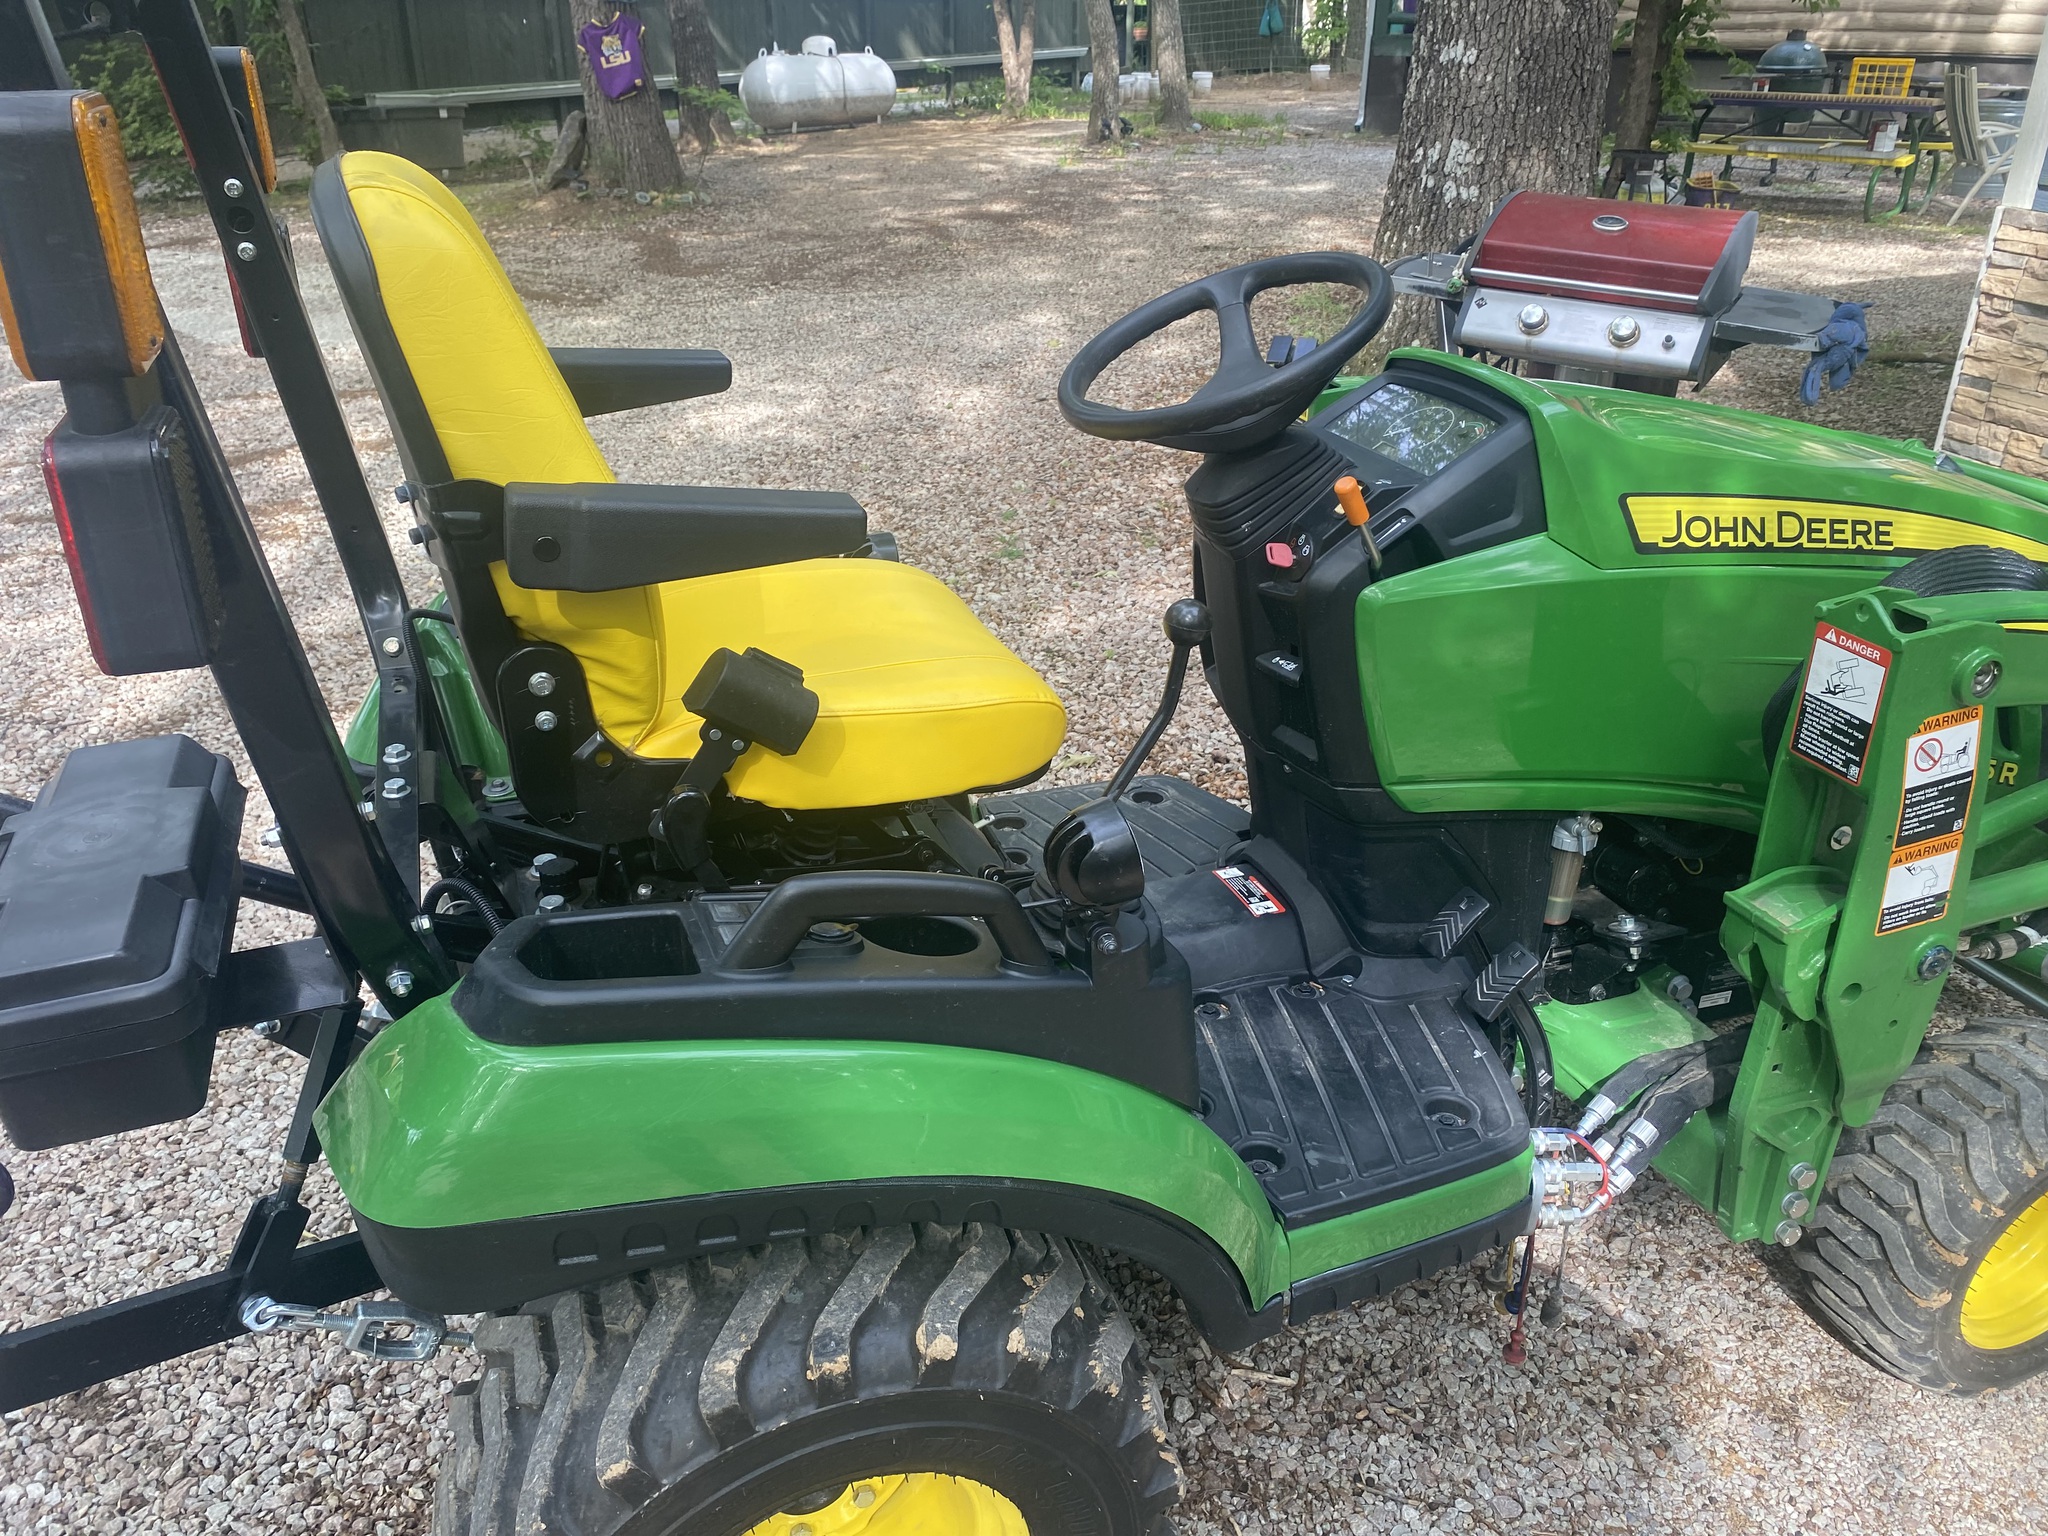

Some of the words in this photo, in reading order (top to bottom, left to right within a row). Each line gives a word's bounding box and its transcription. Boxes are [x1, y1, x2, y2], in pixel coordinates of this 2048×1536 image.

[600, 50, 631, 69] LSU
[1662, 510, 1766, 545] JOHN
[1777, 510, 1894, 547] DEERE
[1838, 635, 1881, 661] DANGER
[1820, 702, 1832, 711] injury
[1838, 711, 1850, 720] death
[1923, 708, 1979, 731] WARNING
[1820, 714, 1834, 724] handle
[1834, 721, 1847, 730] round
[1853, 730, 1864, 740] large
[1832, 732, 1848, 743] seatbelt
[1800, 733, 1810, 741] Move
[1811, 739, 1825, 749] wheels
[1832, 749, 1845, 759] widest
[1801, 728, 1817, 739] Operate
[1818, 736, 1831, 747] tractor
[1845, 751, 1859, 761] speed.
[1806, 748, 1823, 759] required
[1912, 789, 1924, 797] avoid
[1924, 786, 1937, 794] injury
[1903, 817, 1918, 825] Handle
[1904, 838, 1959, 861] WARNING
